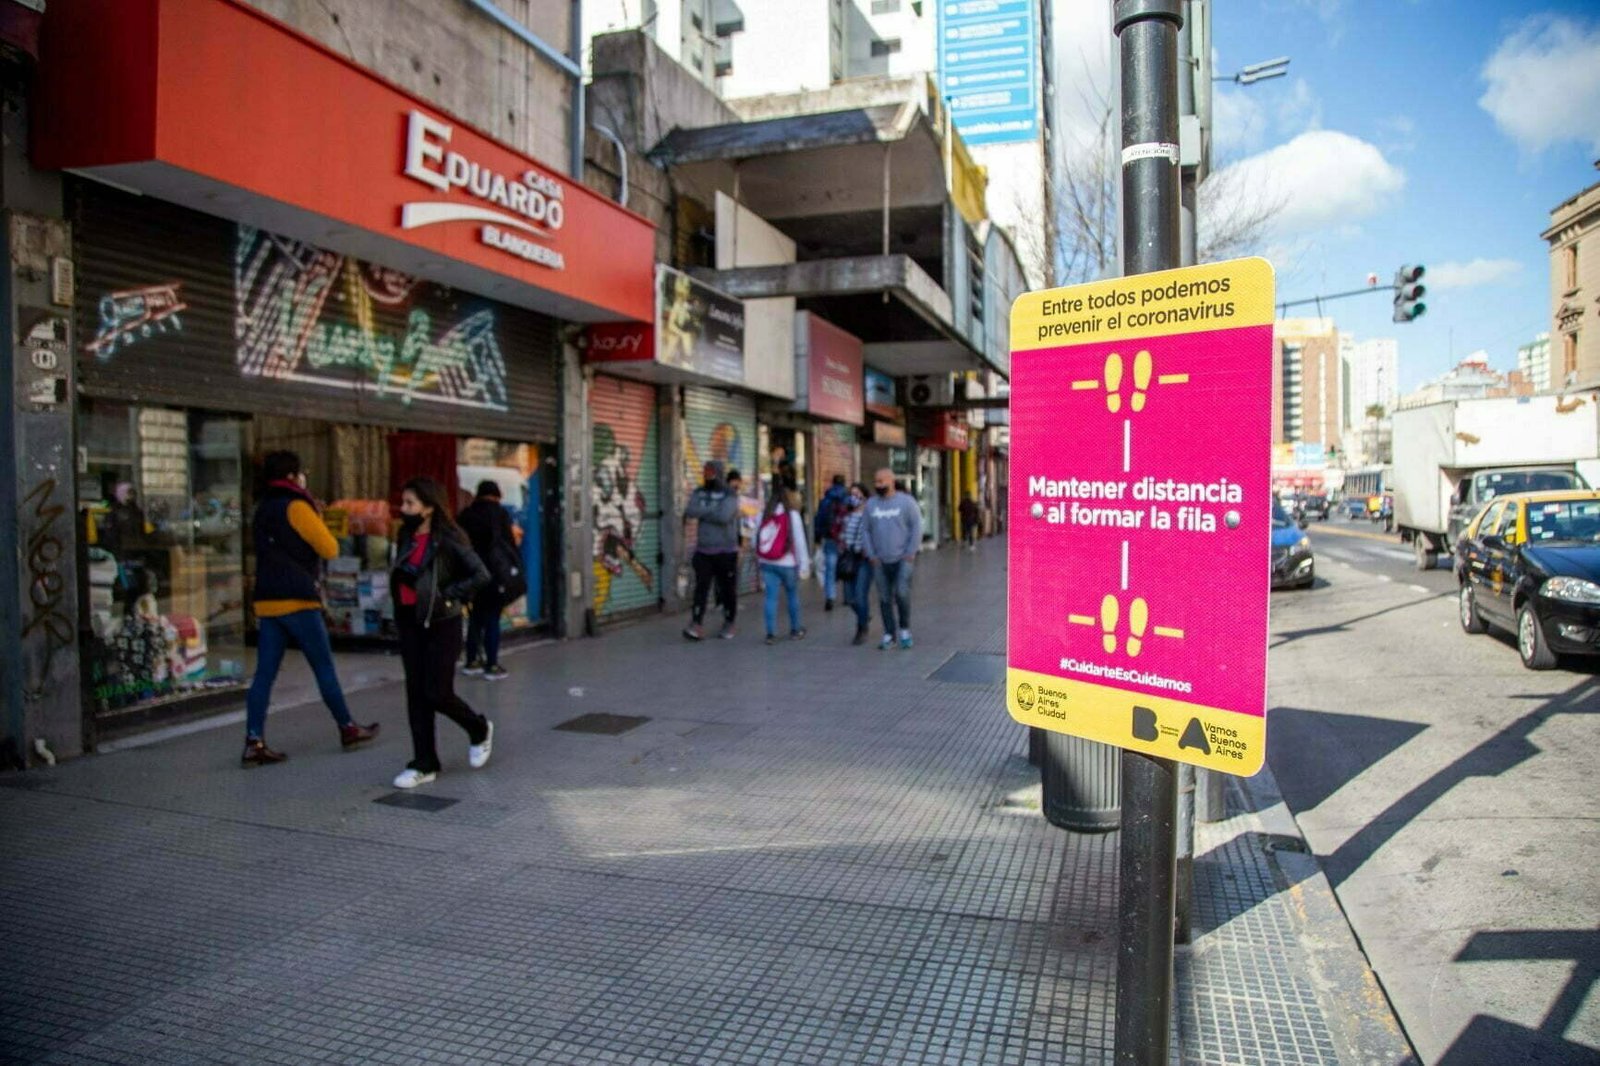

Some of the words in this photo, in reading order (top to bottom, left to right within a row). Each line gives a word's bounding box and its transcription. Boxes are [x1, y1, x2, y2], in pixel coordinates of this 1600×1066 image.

[403, 109, 564, 230] EDUARDO
[523, 170, 565, 202] CASA
[1042, 296, 1083, 316] Entre
[1087, 290, 1136, 310] todos
[1141, 277, 1231, 304] podemos
[1038, 316, 1102, 341] prevenir
[1107, 312, 1122, 330] el
[1126, 301, 1235, 327] coronavirus
[1028, 475, 1128, 500] Mantener
[1132, 477, 1243, 503] distancia
[1047, 503, 1066, 524] al
[1071, 502, 1146, 529] formar
[1150, 505, 1171, 530] la
[1177, 506, 1217, 533] fila
[1060, 657, 1193, 693] #CuidarteEsCuidarnos
[1037, 685, 1068, 700] Buenos
[1037, 695, 1060, 708] Aires
[1037, 705, 1066, 720] Ciudad
[1203, 721, 1238, 738] Vamos
[1210, 733, 1247, 750] Buenos
[1215, 746, 1244, 760] Aires
